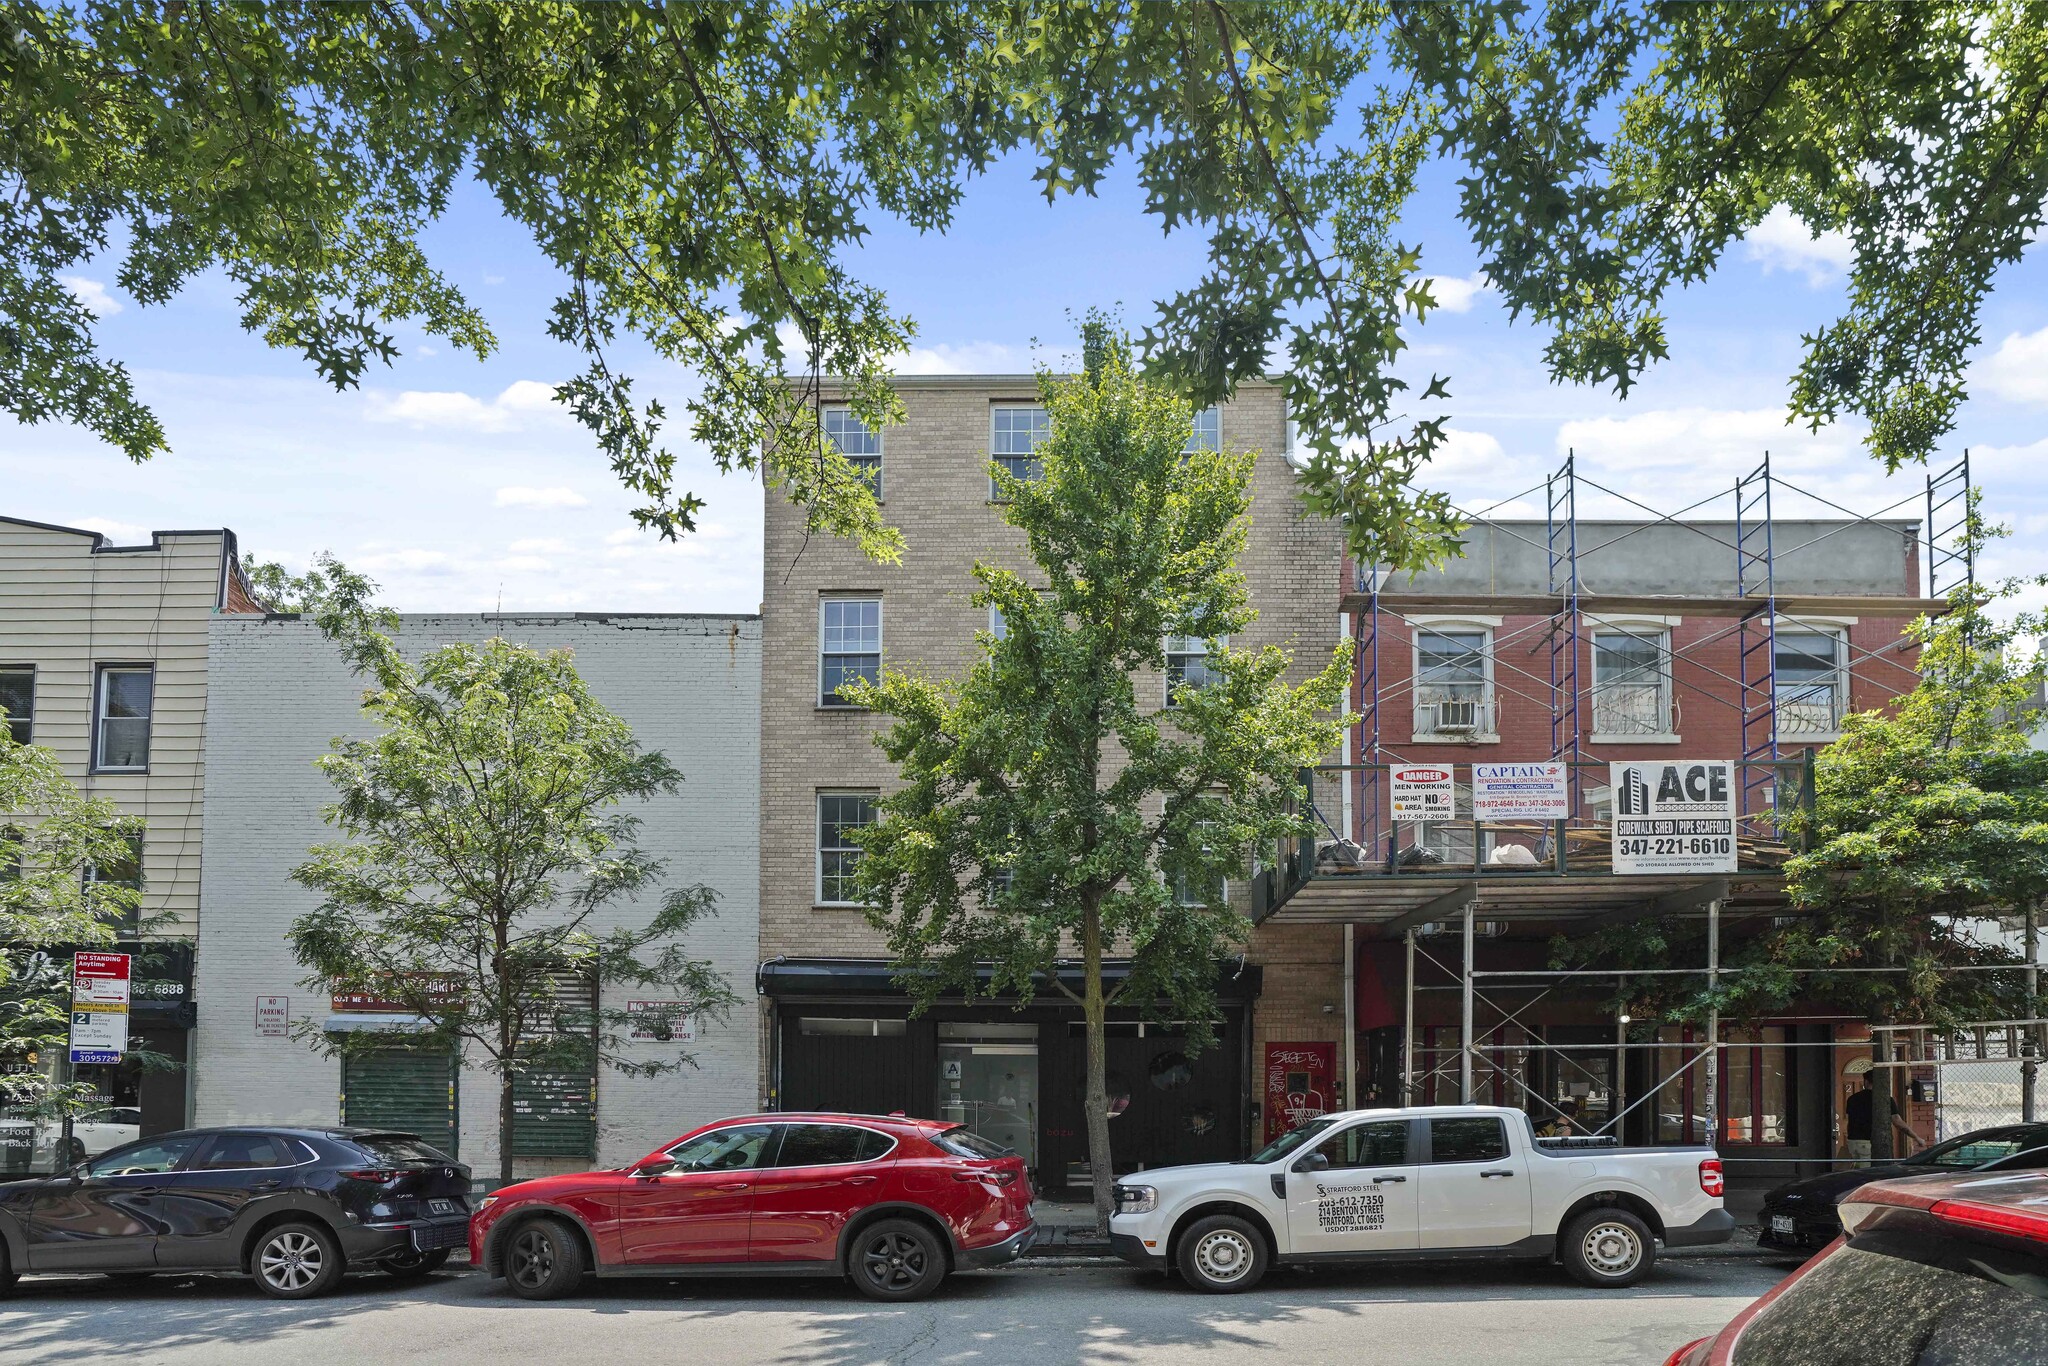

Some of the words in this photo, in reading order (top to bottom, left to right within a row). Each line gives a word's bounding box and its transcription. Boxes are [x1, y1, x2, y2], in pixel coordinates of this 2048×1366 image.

[1402, 771, 1442, 780] DANGER
[1477, 766, 1545, 777] CAPTAIN
[1656, 765, 1728, 802] ACE
[1425, 794, 1438, 804] NO
[1619, 821, 1654, 835] SIDEWALK
[1655, 821, 1674, 834] SHED
[1679, 821, 1694, 834] PIPE
[1696, 820, 1730, 833] SCAFFOLD
[1620, 838, 1730, 855] 347-221-6610
[630, 1002, 644, 1011] NO
[77, 1014, 86, 1023] 2
[948, 1064, 958, 1074] A
[74, 1094, 114, 1103] Massage
[8, 1139, 31, 1147] Back
[1319, 1195, 1384, 1207] 203-612-7350
[1319, 1208, 1330, 1216] 214
[1332, 1206, 1358, 1216] BENTON
[1360, 1205, 1383, 1214] STREET
[1319, 1216, 1356, 1226] STRATFORD,
[1357, 1215, 1365, 1224] CT
[1366, 1215, 1384, 1224] 06615
